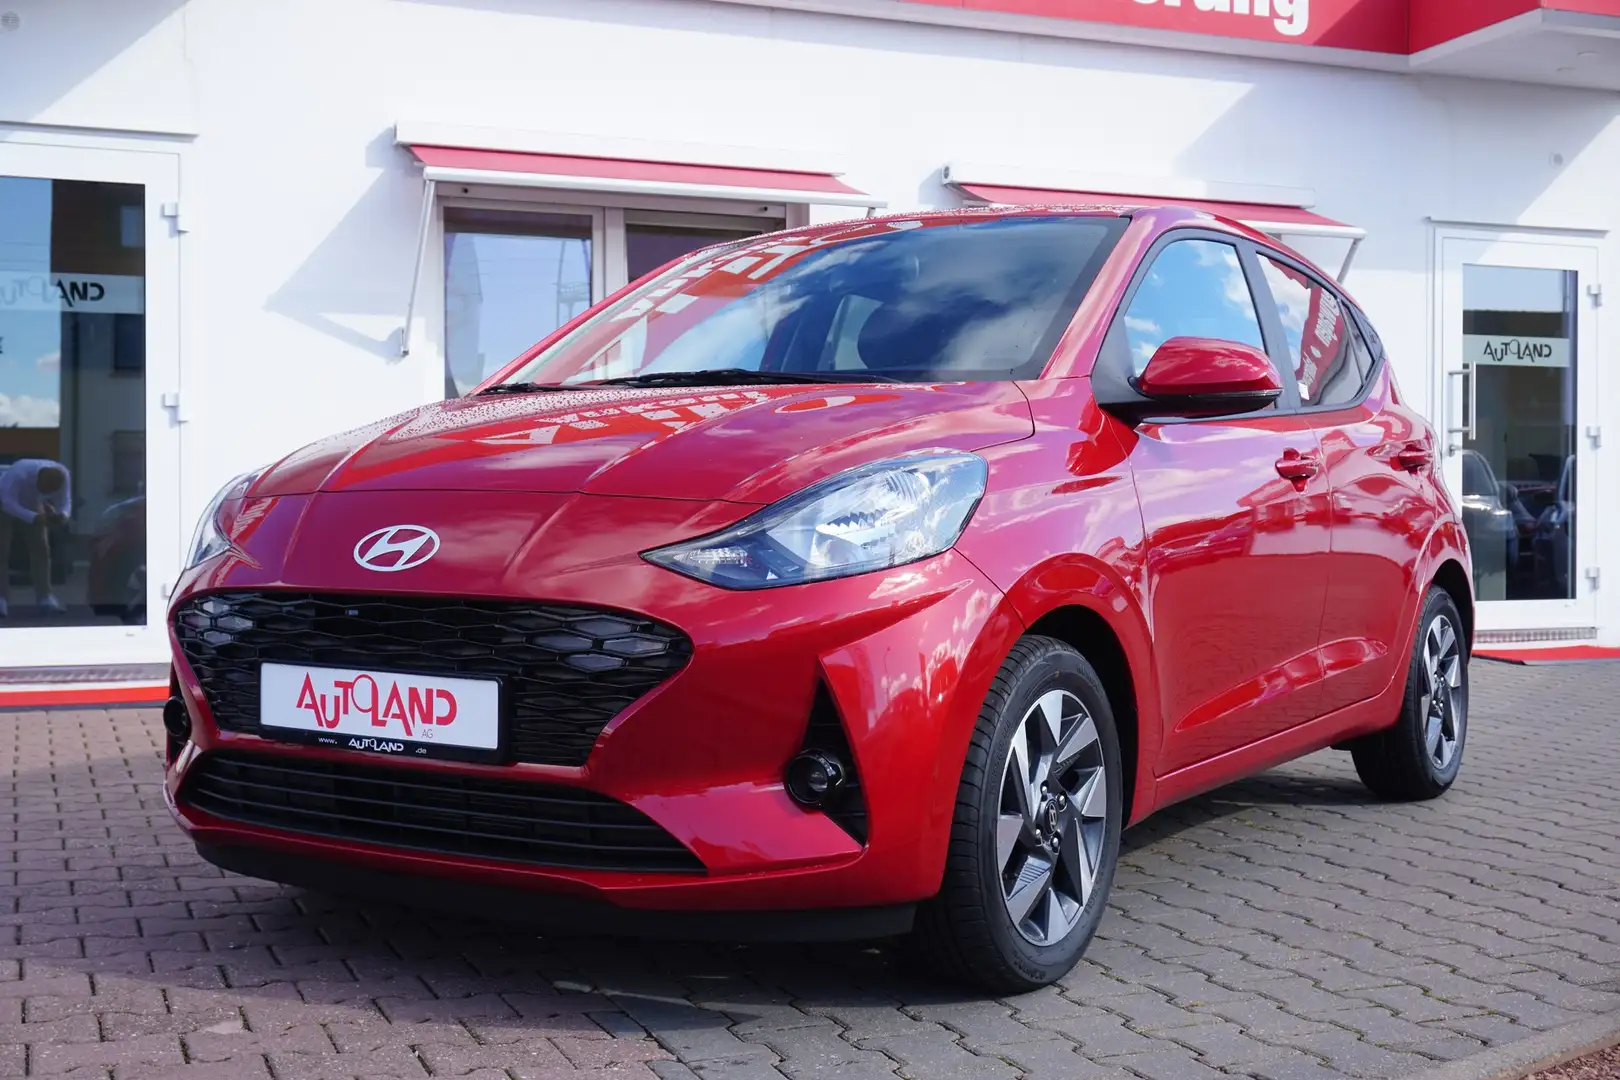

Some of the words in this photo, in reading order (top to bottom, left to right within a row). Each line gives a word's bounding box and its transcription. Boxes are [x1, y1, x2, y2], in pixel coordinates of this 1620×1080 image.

[1483, 338, 1552, 363] AUTOLAND
[296, 671, 457, 736] AUTOLAND
[421, 729, 433, 739] AG
